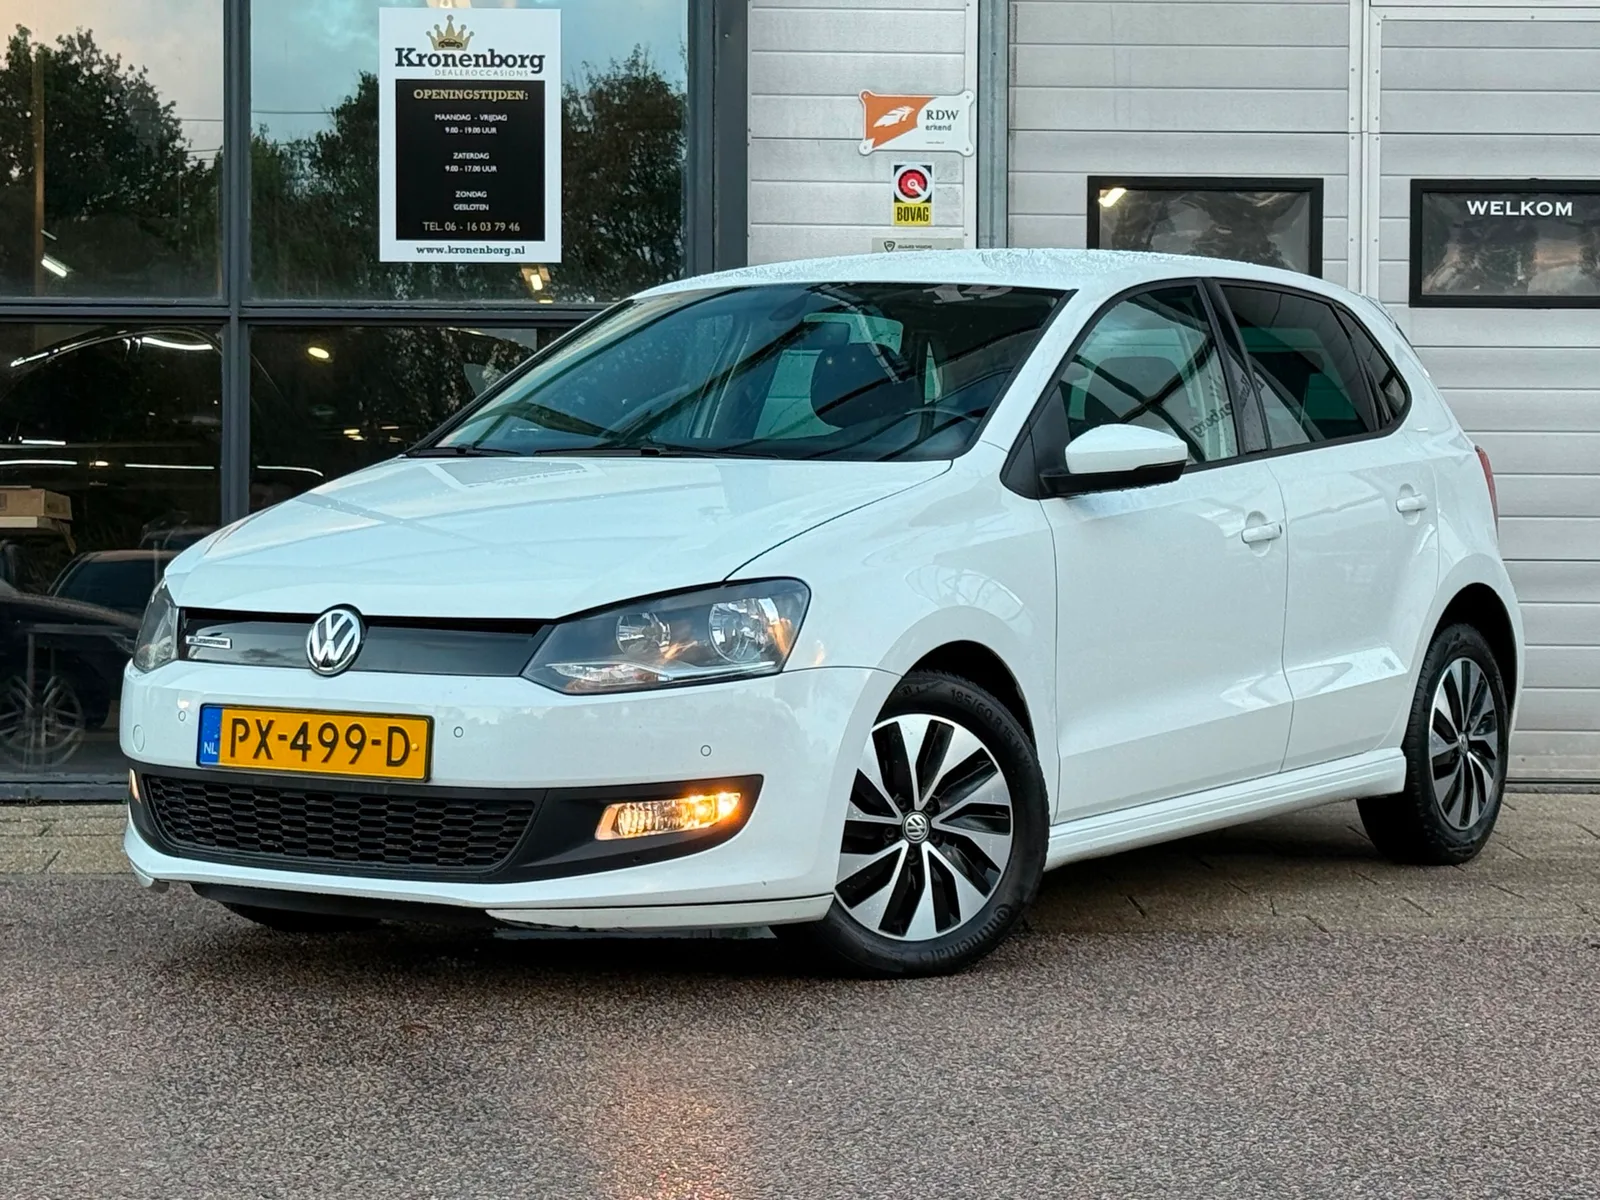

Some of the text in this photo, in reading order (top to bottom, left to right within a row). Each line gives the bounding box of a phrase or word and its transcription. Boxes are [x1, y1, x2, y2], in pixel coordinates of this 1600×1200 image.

[395, 48, 546, 74] Kronenborg
[434, 69, 529, 77] DEALEROCCASIONS
[413, 89, 529, 102] OPENINGSTIJDEN:
[479, 114, 508, 122] VRIJDAG
[925, 109, 960, 121] RDW
[444, 126, 459, 134] 9.00
[925, 124, 952, 132] erkend
[453, 152, 490, 160] ZATERDAG
[896, 206, 930, 222] BOVAG
[1466, 200, 1573, 216] WELKOM
[444, 221, 457, 231] 06
[467, 221, 478, 231] 16
[479, 221, 492, 231] 03
[494, 222, 506, 231] 79
[508, 222, 520, 231] 46
[415, 245, 526, 257] www.kronenborg.nl
[307, 609, 362, 674] VW
[203, 741, 218, 755] NL
[229, 717, 411, 767] PX-499-D
